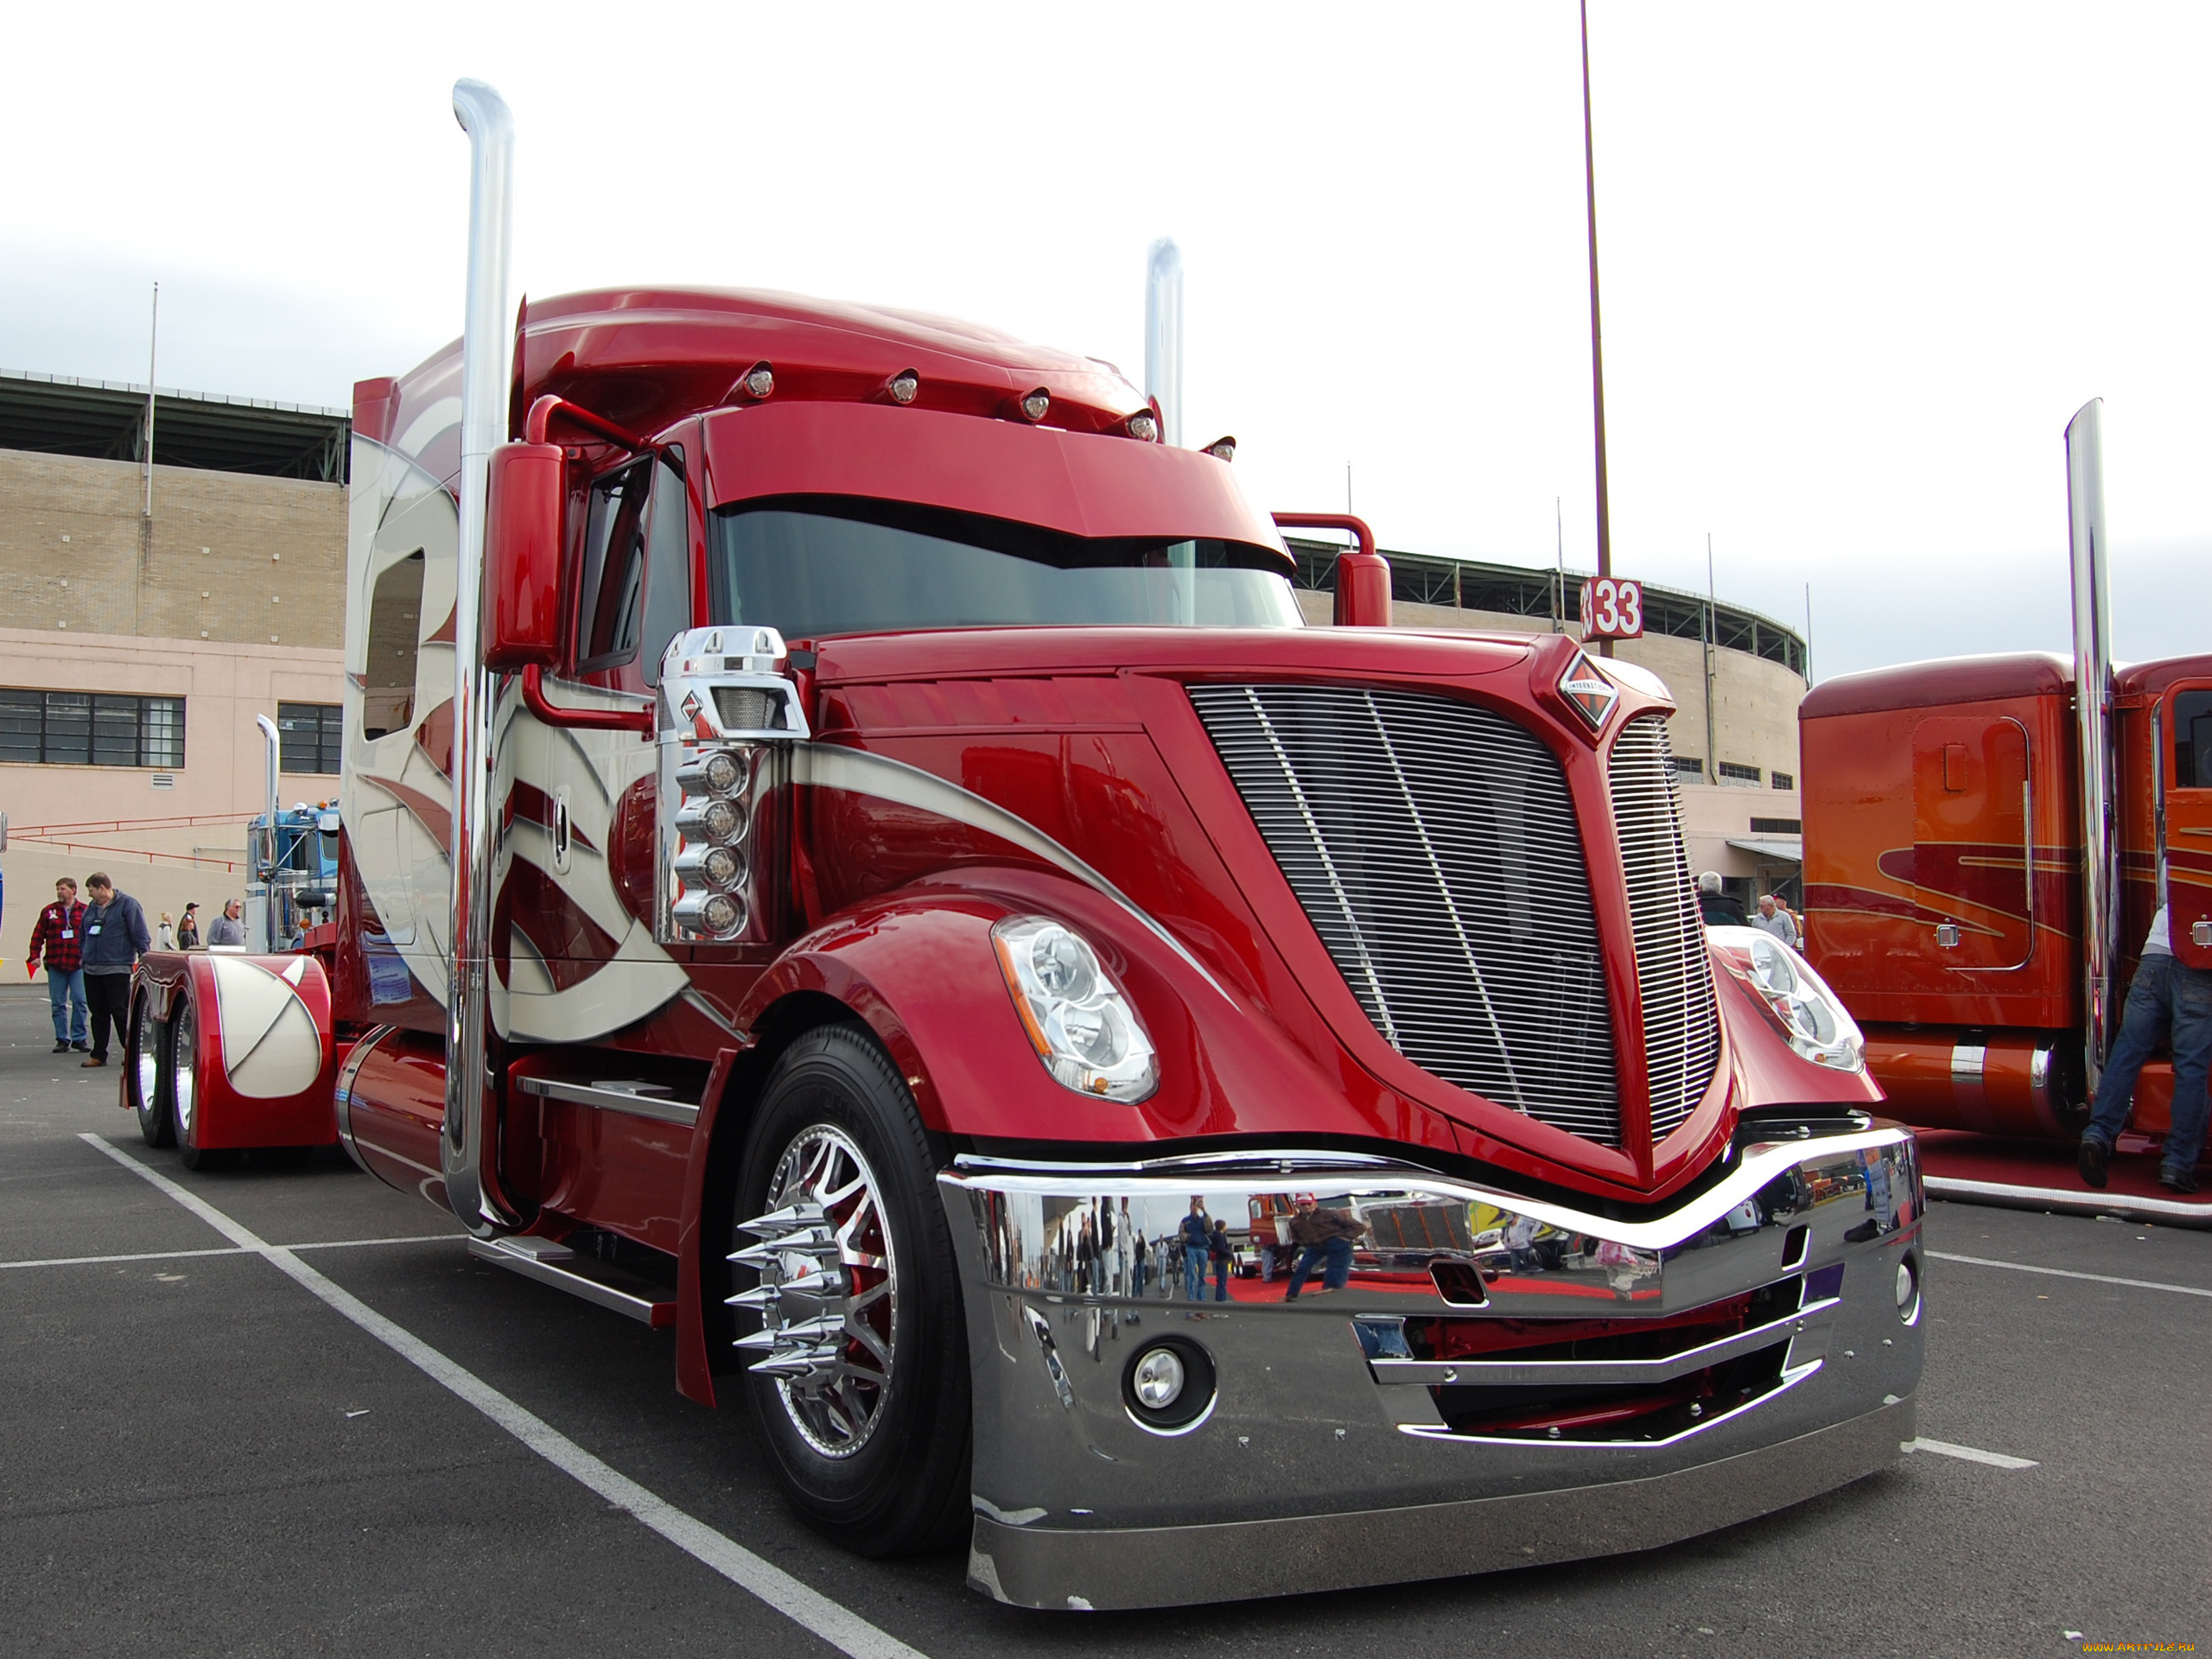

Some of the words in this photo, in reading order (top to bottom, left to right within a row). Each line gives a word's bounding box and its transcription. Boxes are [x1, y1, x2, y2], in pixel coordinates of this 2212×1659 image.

[1580, 582, 1592, 639] 33
[1596, 580, 1641, 635] 33
[1568, 682, 1611, 692] INTERNATION
